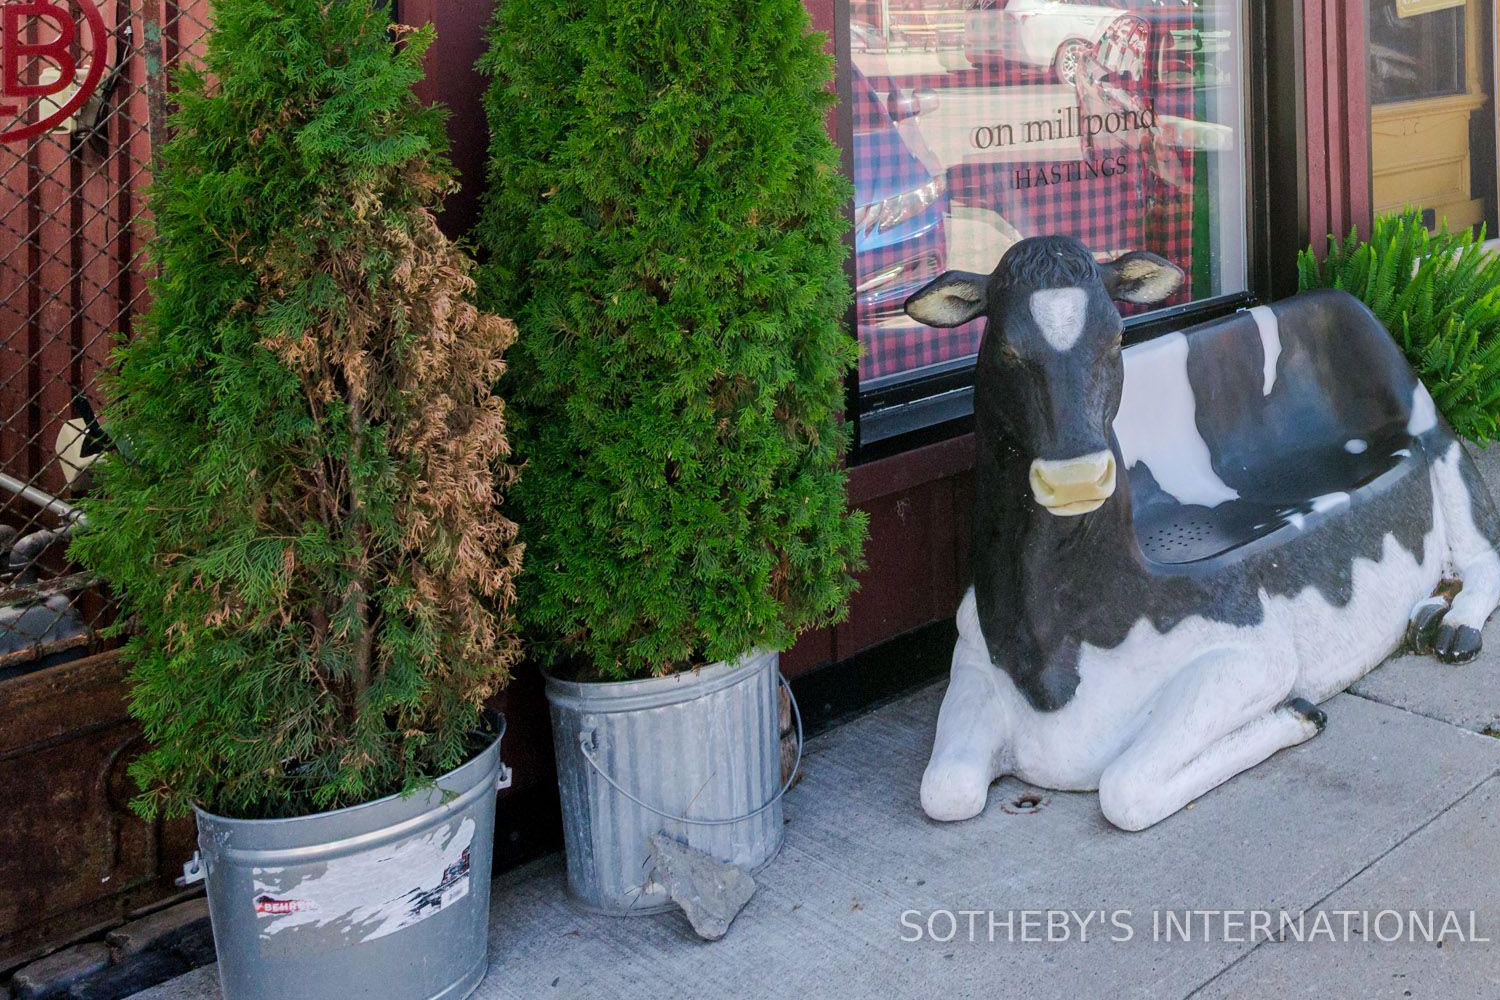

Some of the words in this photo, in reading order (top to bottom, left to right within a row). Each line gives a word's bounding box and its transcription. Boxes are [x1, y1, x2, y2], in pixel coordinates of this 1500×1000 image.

[975, 125, 1015, 150] on
[1023, 98, 1159, 148] millpond
[1016, 155, 1128, 190] HASTINGS
